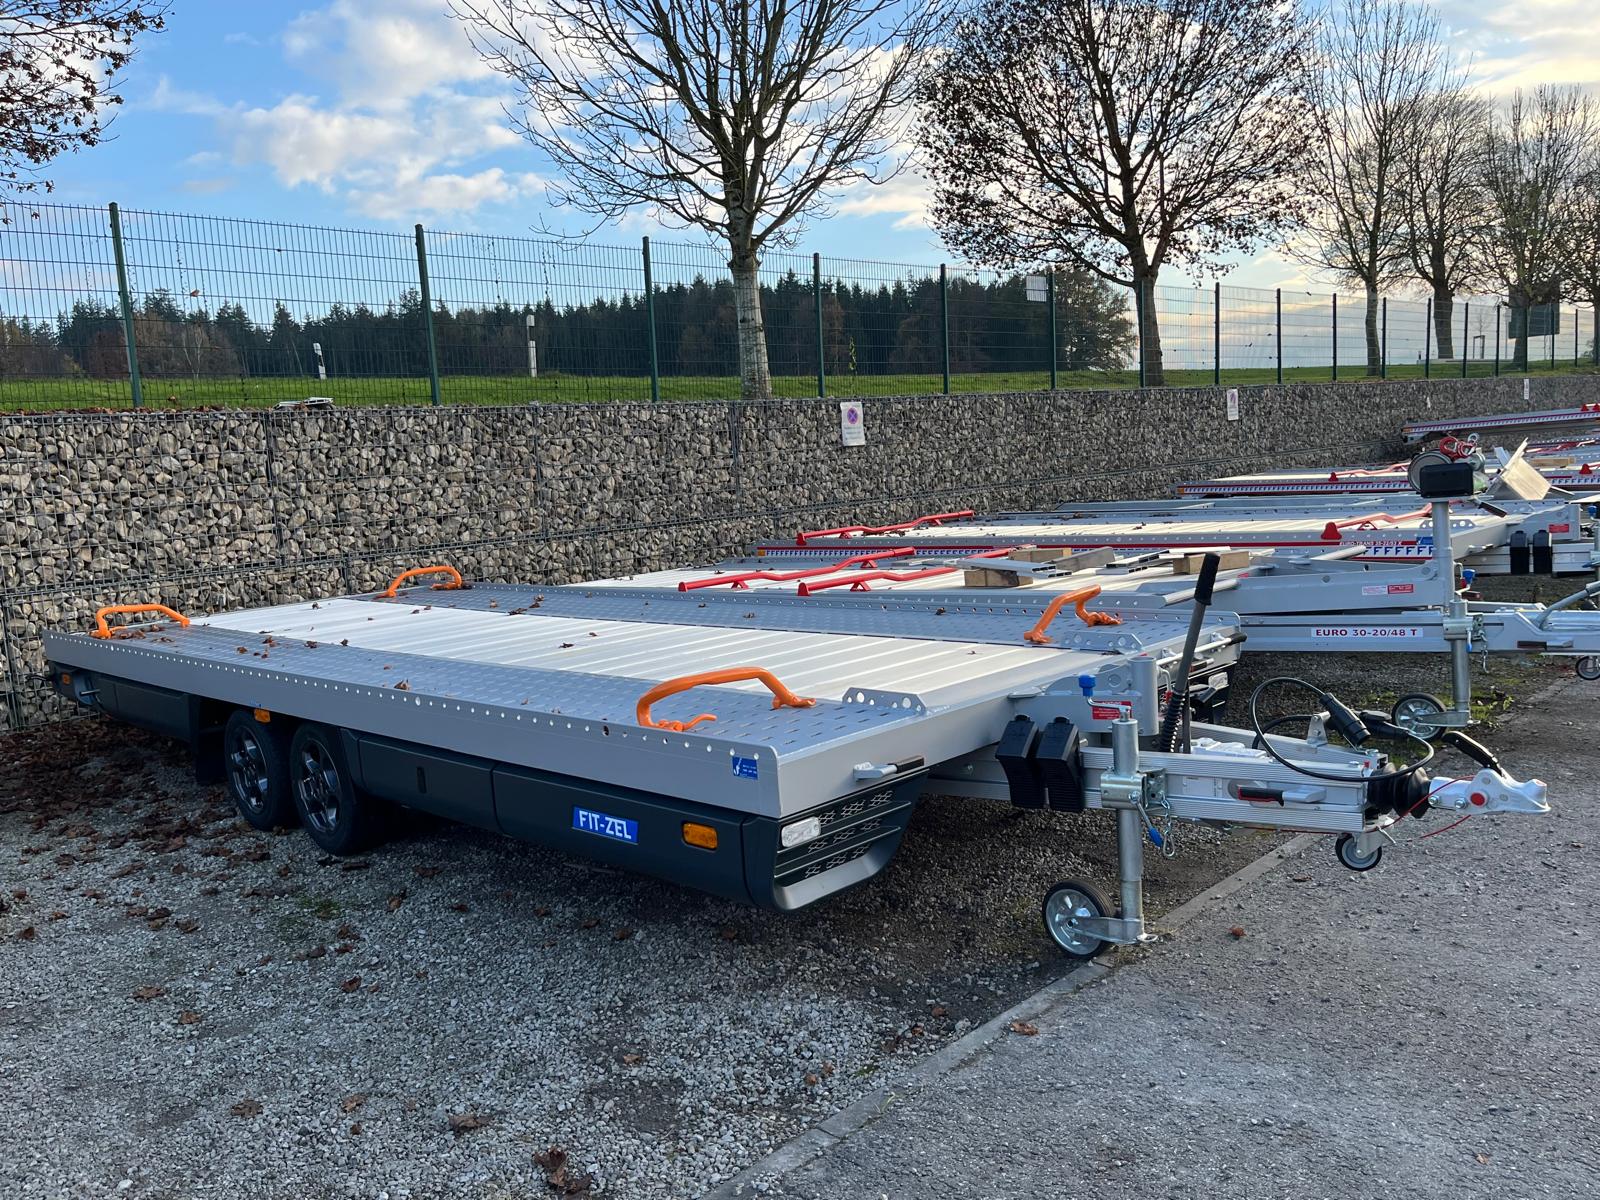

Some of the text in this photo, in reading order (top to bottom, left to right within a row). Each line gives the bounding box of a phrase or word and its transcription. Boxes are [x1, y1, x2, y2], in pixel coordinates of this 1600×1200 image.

[1315, 628, 1418, 637] EURO 30-20/48 T
[578, 809, 632, 840] FIT-ZEL
